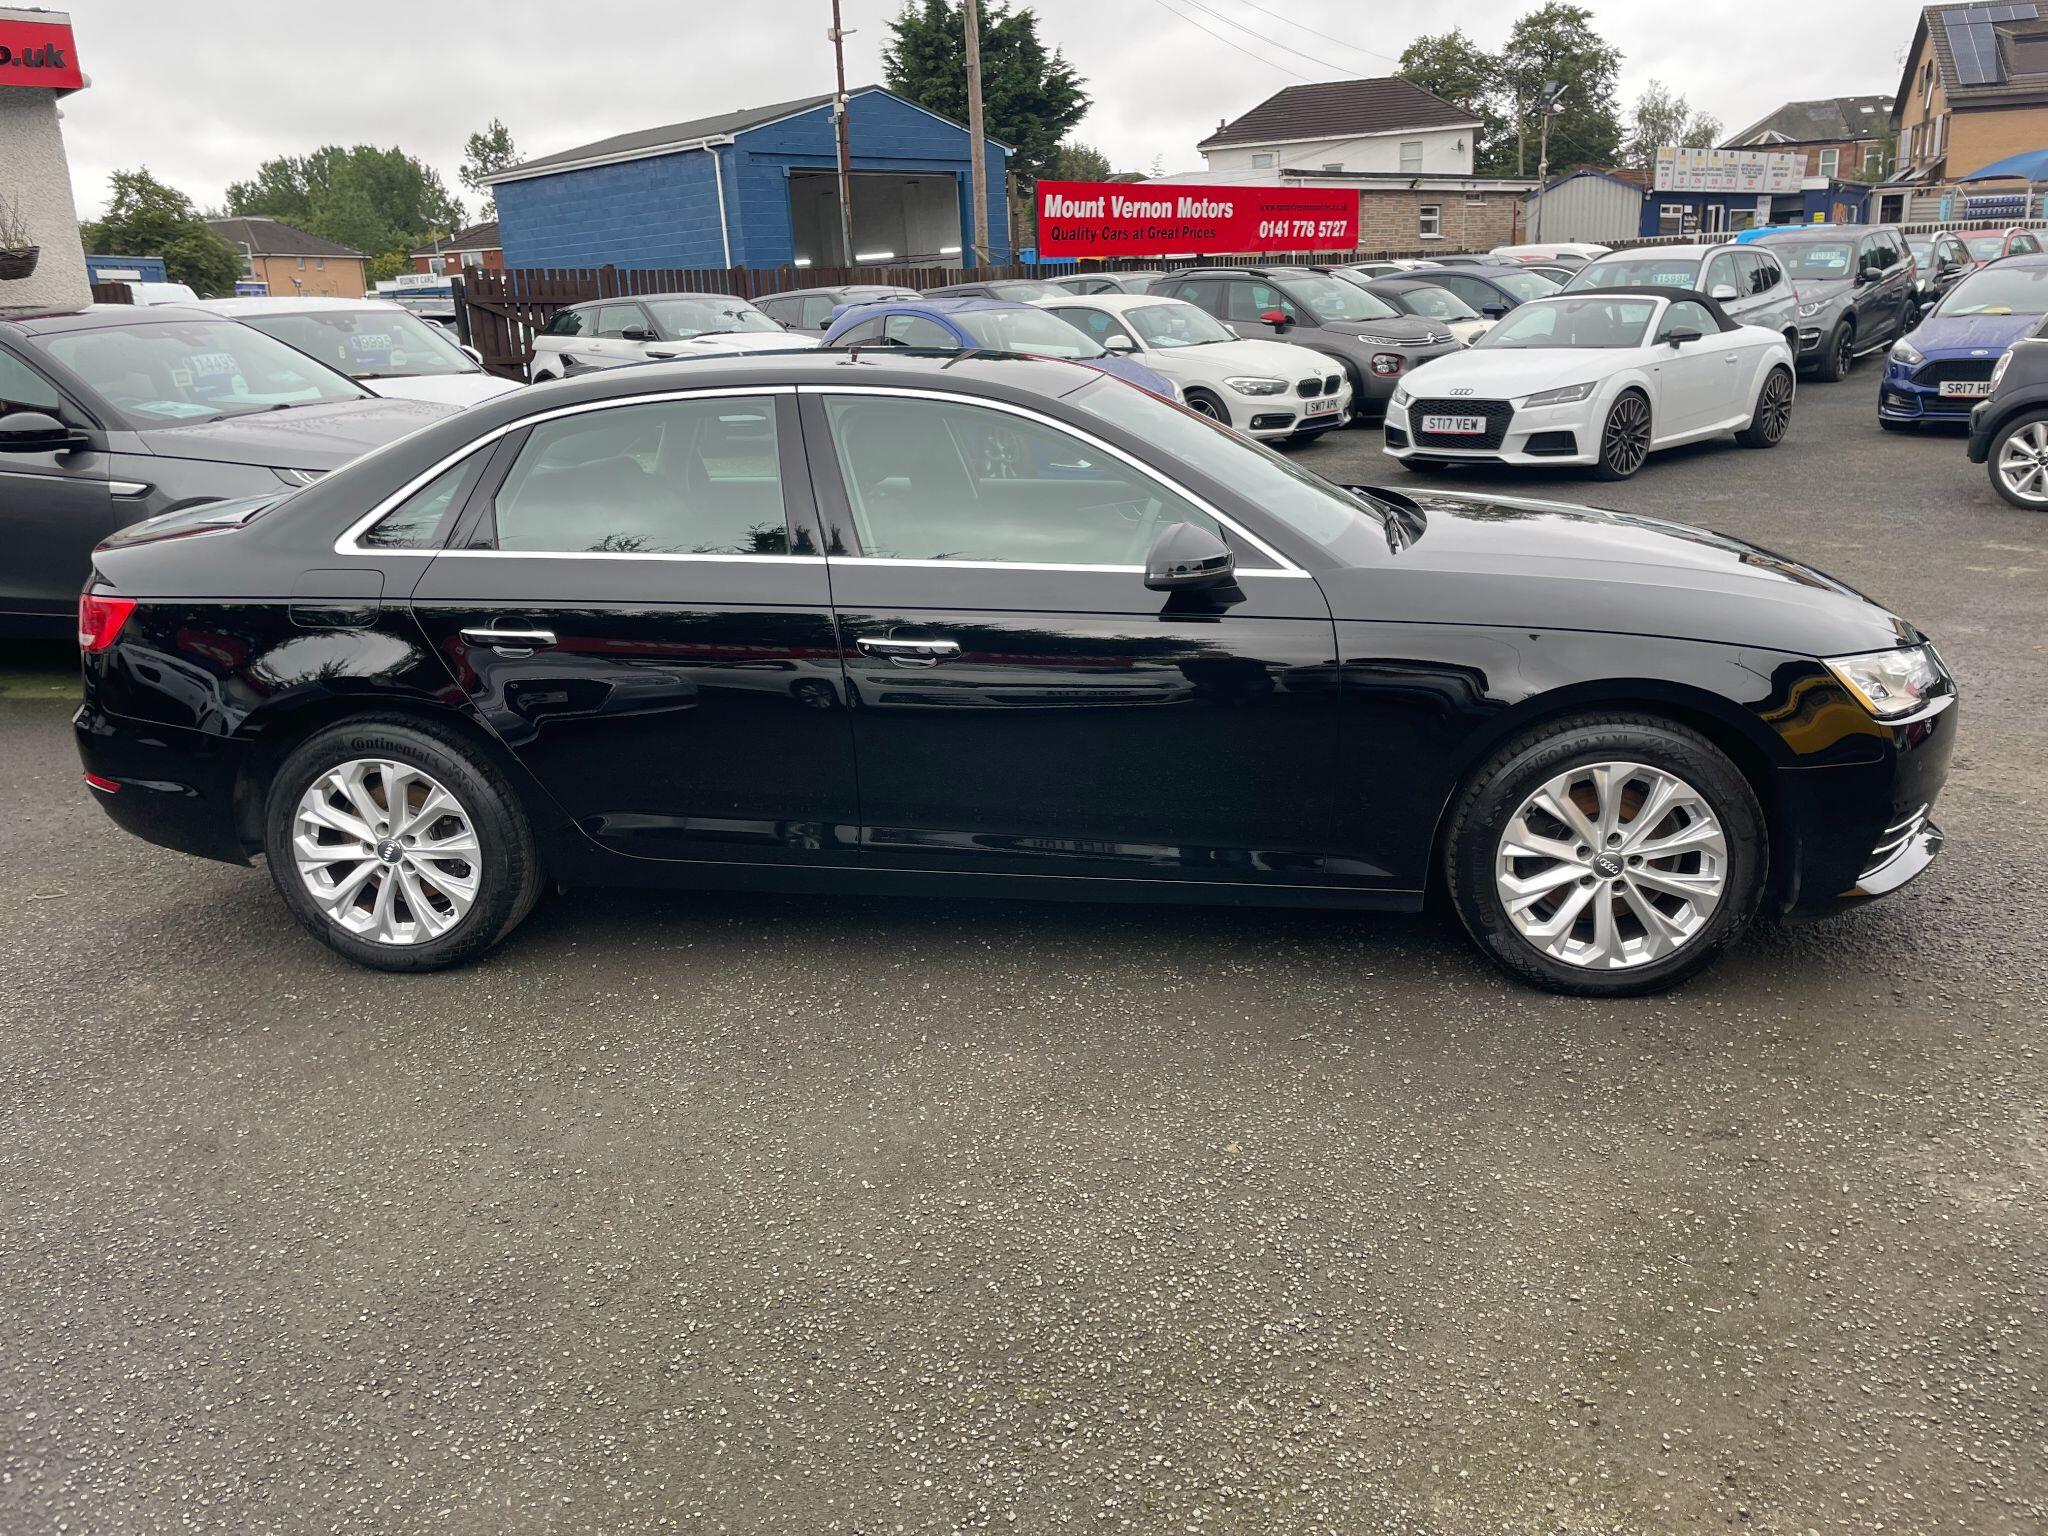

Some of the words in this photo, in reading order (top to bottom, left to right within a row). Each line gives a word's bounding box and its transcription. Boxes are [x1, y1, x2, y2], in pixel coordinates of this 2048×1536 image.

[1044, 194, 1106, 218] Mount
[1111, 195, 1173, 218] Vernon
[1177, 196, 1234, 219] Motors
[1051, 225, 1097, 243] Quality
[1101, 226, 1129, 241] Cars
[1132, 227, 1144, 240] at
[1147, 226, 1179, 240] Great
[1182, 225, 1216, 239] Prices
[1259, 220, 1289, 238] 0141
[1292, 220, 1316, 238] 778
[1318, 220, 1348, 238] 5727
[1947, 383, 1975, 394] SR17
[1311, 402, 1325, 413] SW17
[1429, 417, 1453, 430] ST17
[1456, 418, 1478, 431] VEW
[351, 737, 431, 763] Continental
